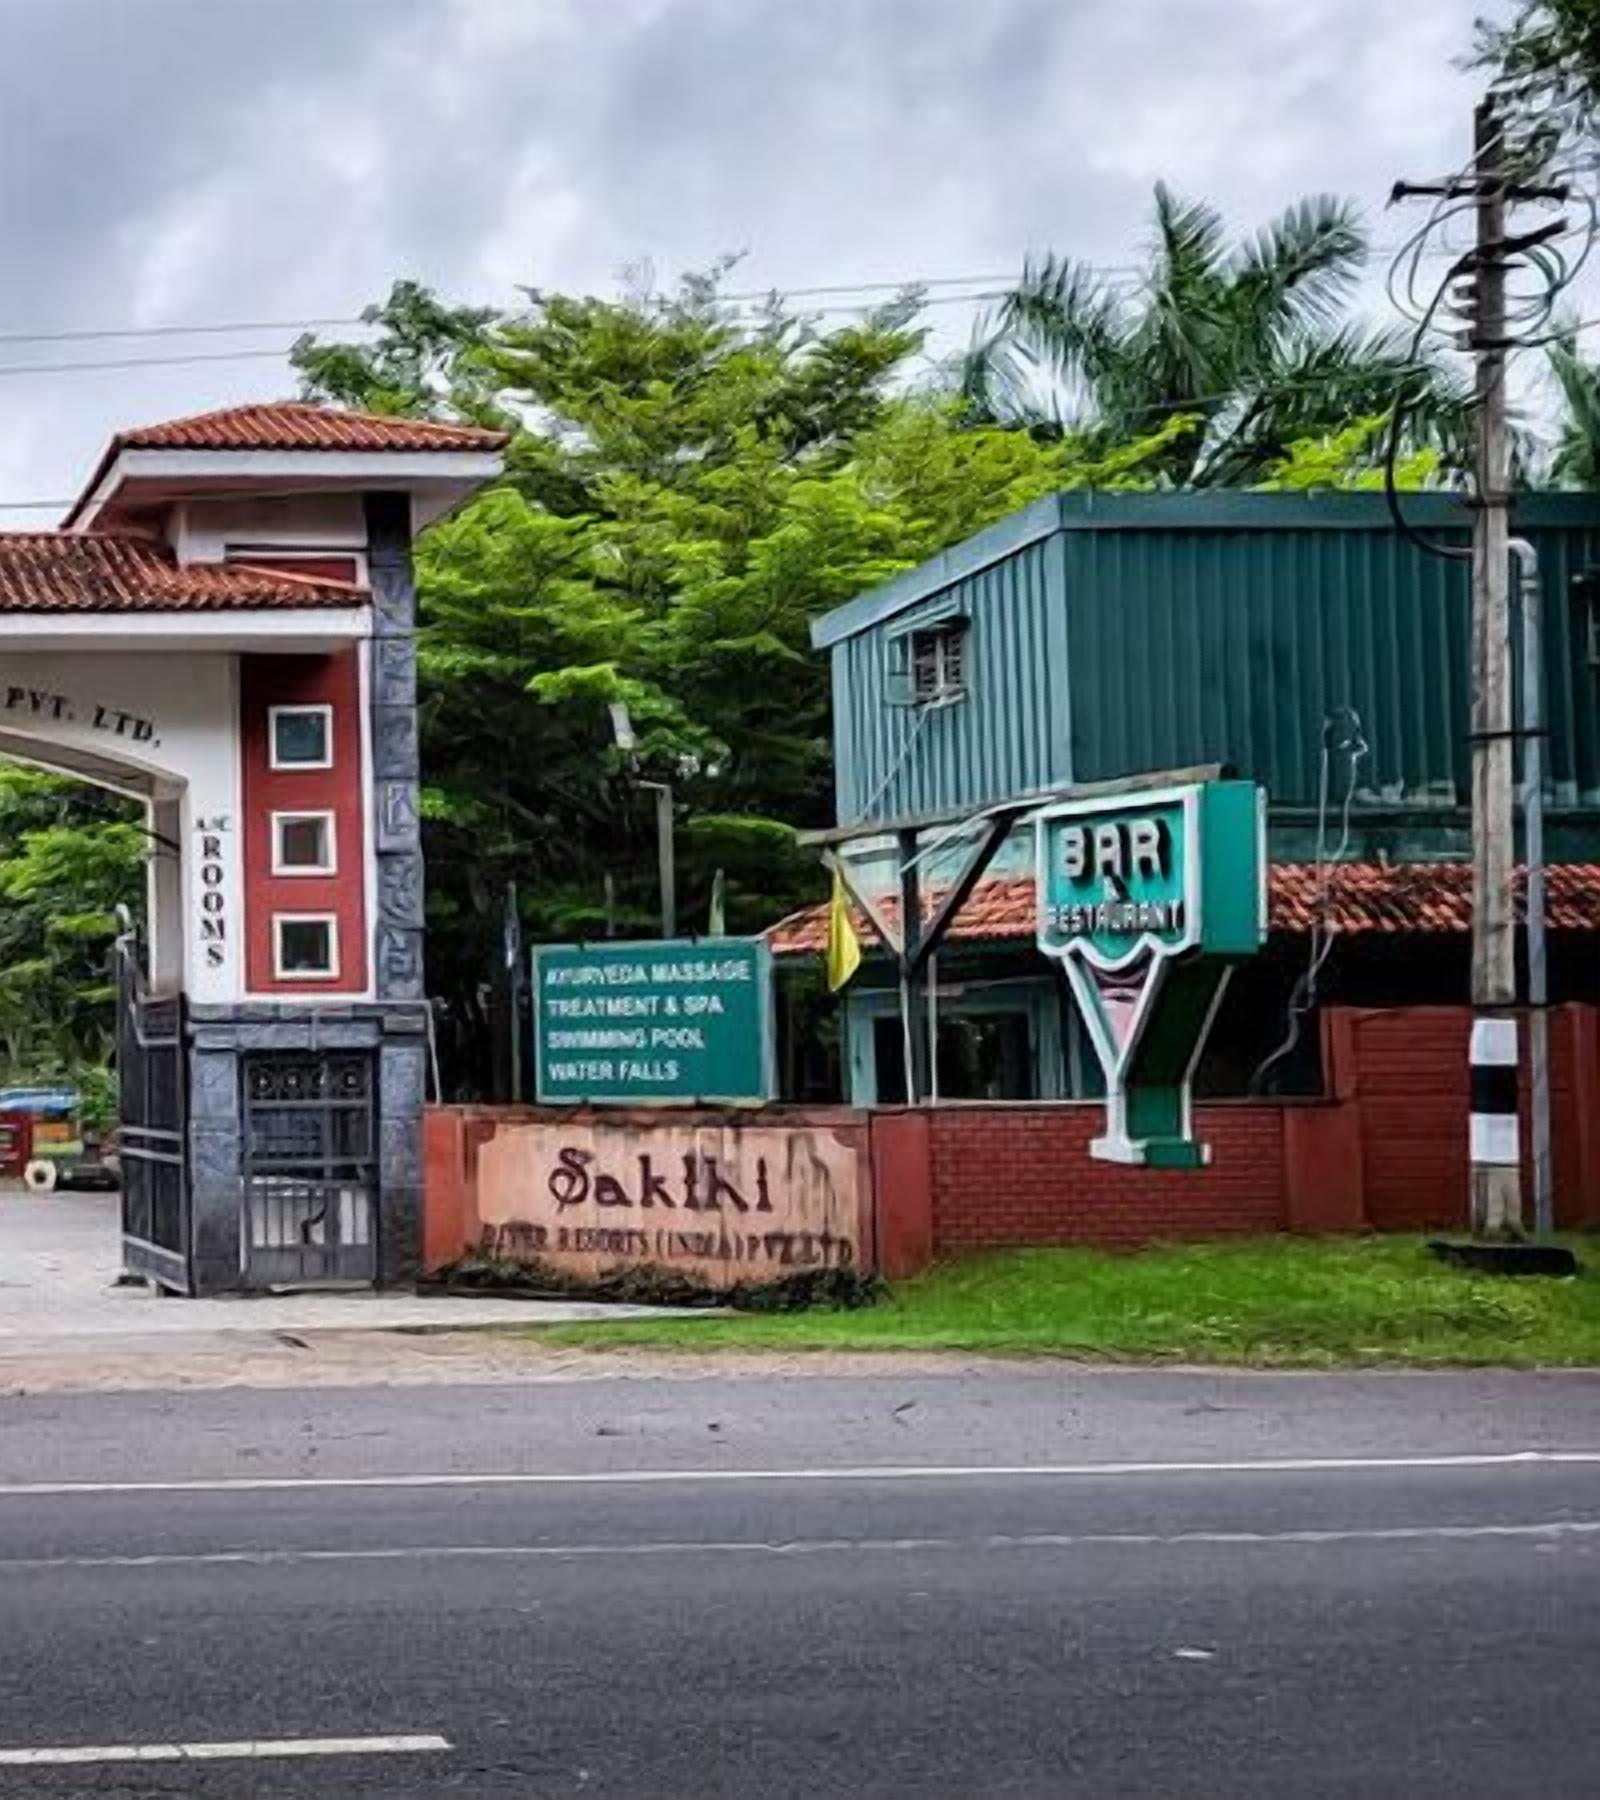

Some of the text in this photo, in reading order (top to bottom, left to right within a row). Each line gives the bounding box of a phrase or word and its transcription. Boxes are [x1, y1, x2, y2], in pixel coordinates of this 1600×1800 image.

[6, 687, 74, 720] PVT.
[1058, 819, 1166, 880] BAR
[200, 835, 225, 968] ROOMS
[546, 959, 750, 985] AYURVEDA MASSAGE
[547, 995, 724, 1017] TREATMENT & SPA
[548, 1027, 704, 1049] SWIMMING POOL
[548, 1060, 680, 1082] WATER FALLS
